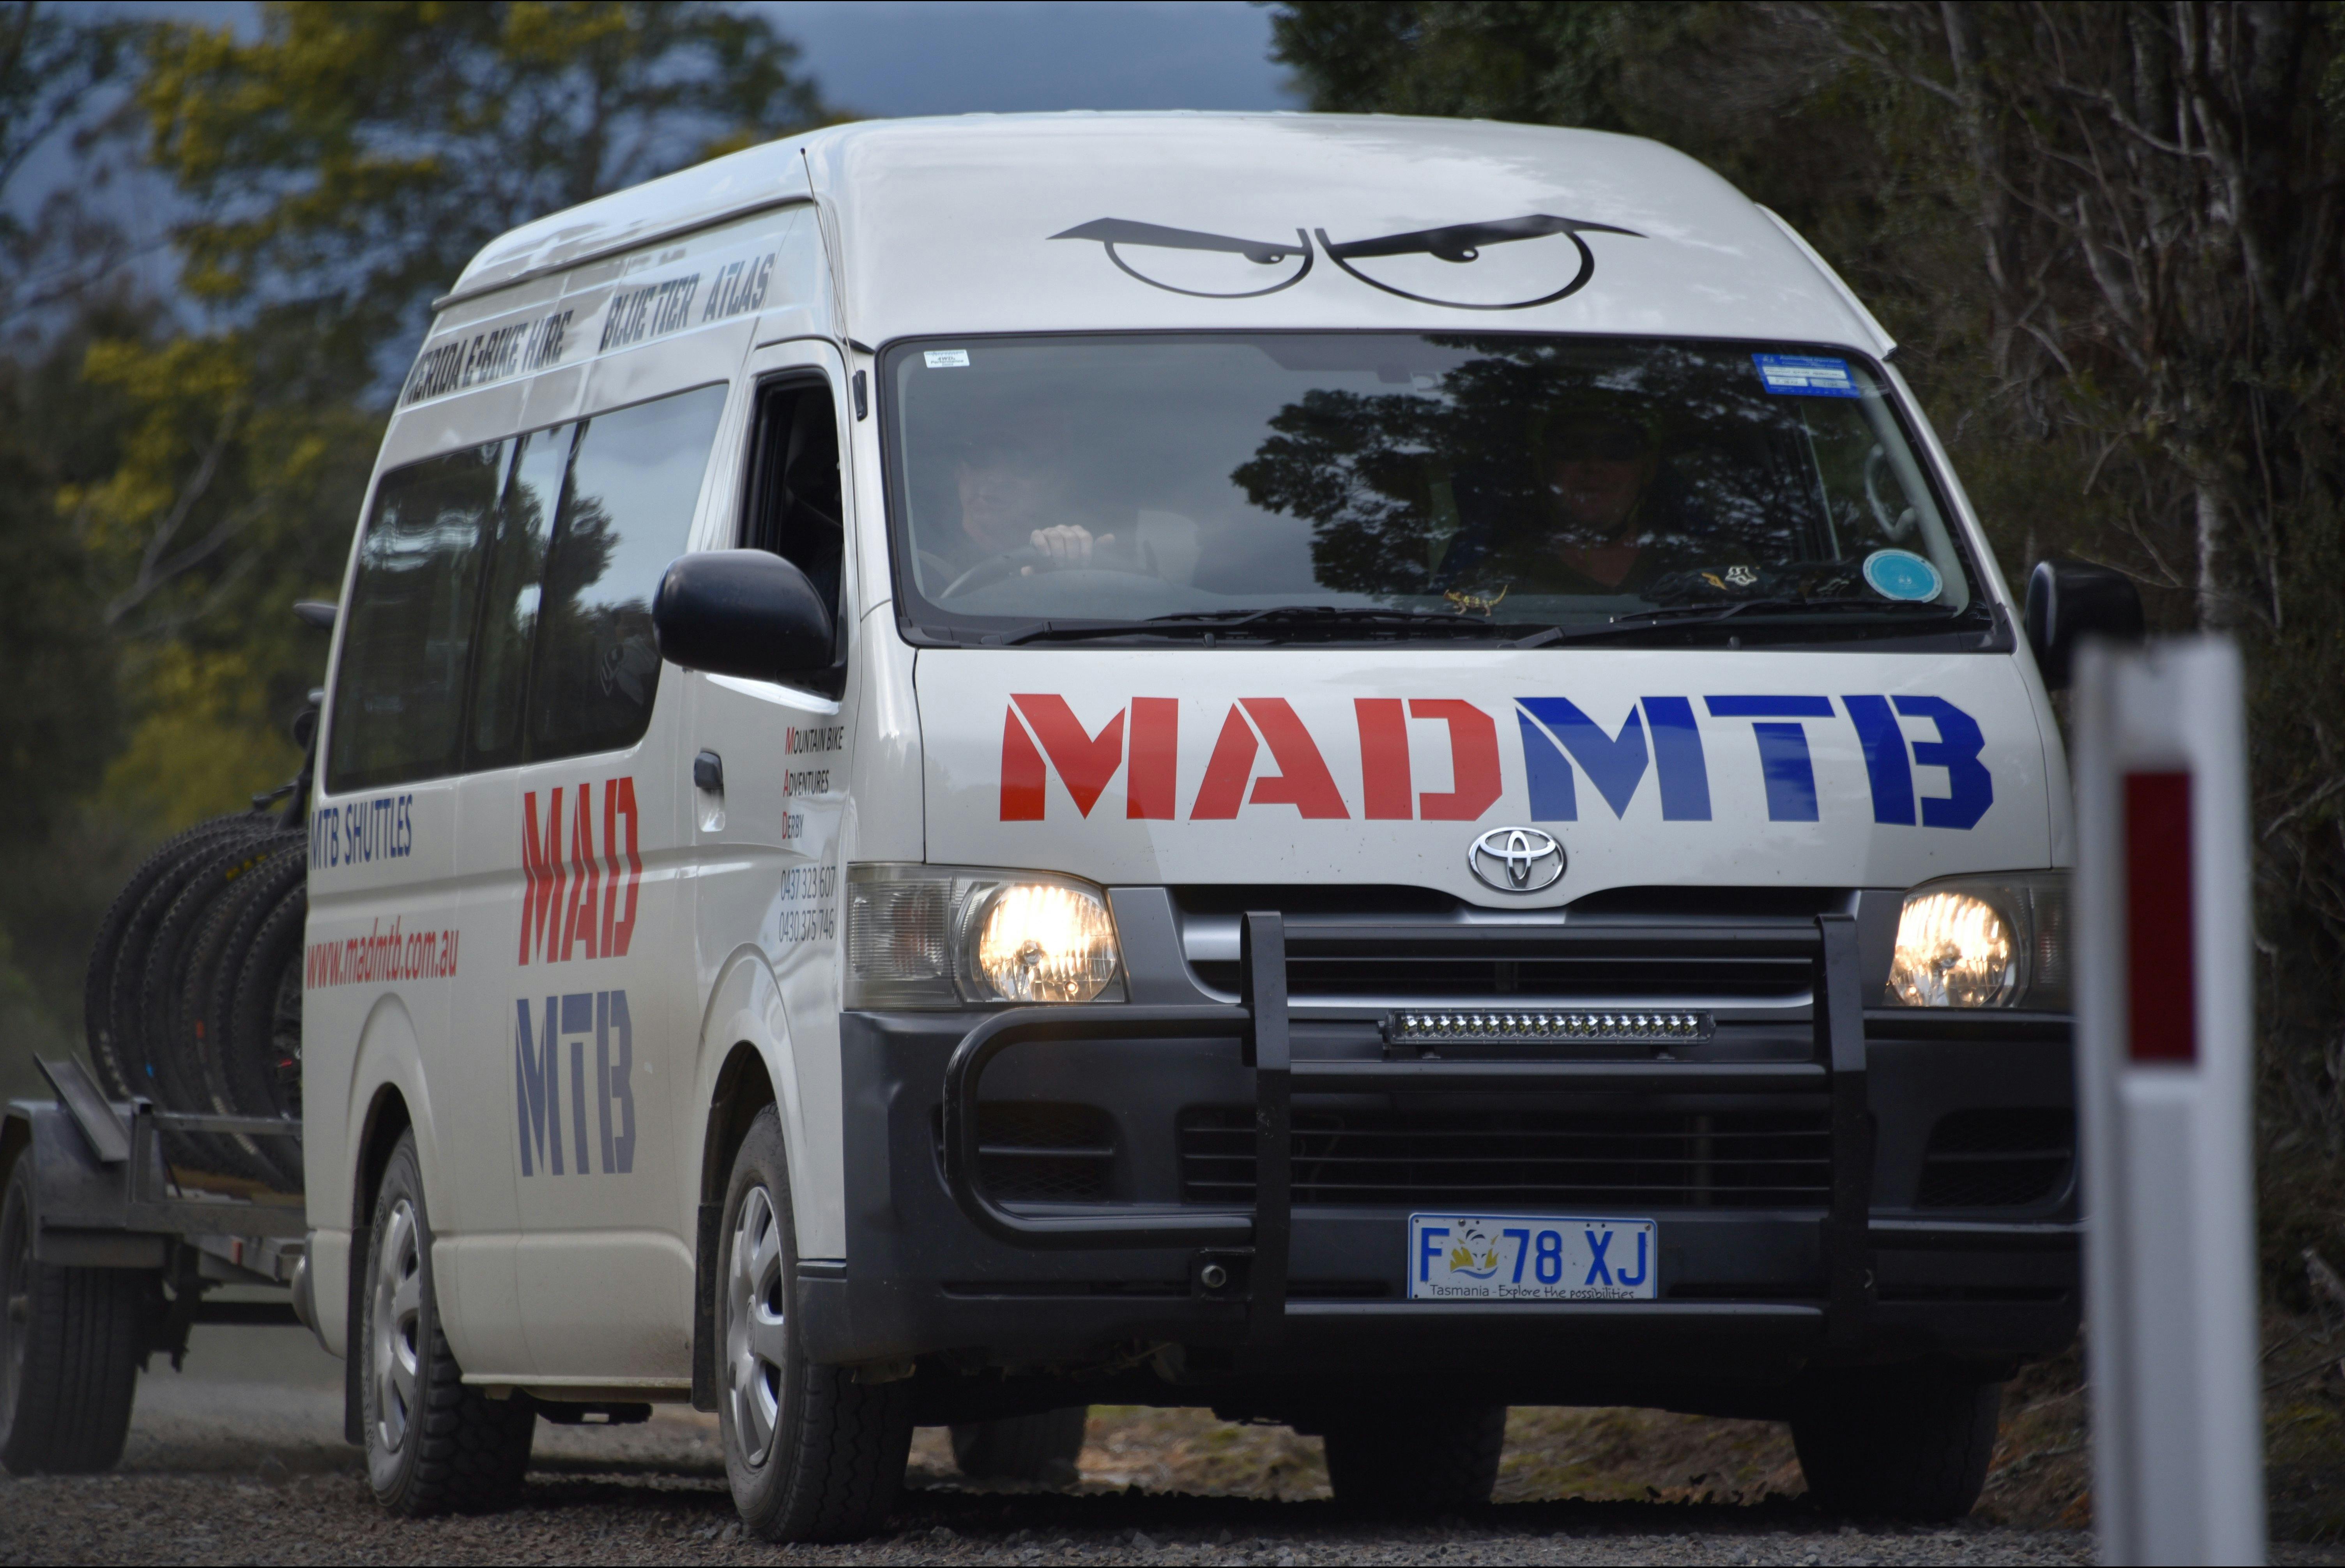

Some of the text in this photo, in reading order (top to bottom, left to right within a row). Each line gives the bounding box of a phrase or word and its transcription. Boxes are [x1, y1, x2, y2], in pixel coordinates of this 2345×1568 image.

[462, 322, 529, 388] E-BIKE
[521, 309, 575, 373] HIRE
[598, 286, 657, 353] BLUE
[650, 273, 700, 337] TIER
[702, 253, 776, 322] ATLAS
[785, 726, 844, 755] MOUNTAIN BIKE
[783, 769, 829, 797] ADVENTURES
[310, 807, 339, 871] MTB
[345, 794, 413, 866] SHUTTLES
[782, 811, 804, 839] DERBY
[518, 776, 643, 966] MAD
[781, 866, 836, 901] 0437 323 607
[779, 909, 834, 943] 0430 375 746
[307, 914, 459, 990] www.madmtb.com.au
[515, 990, 636, 1177] MTB
[1420, 1227, 1646, 1286] F 78 XJ
[1430, 1285, 1489, 1296] Tasmania
[1499, 1285, 1541, 1299] Explore
[1544, 1285, 1566, 1298] the
[1570, 1286, 1634, 1298] possibilities
